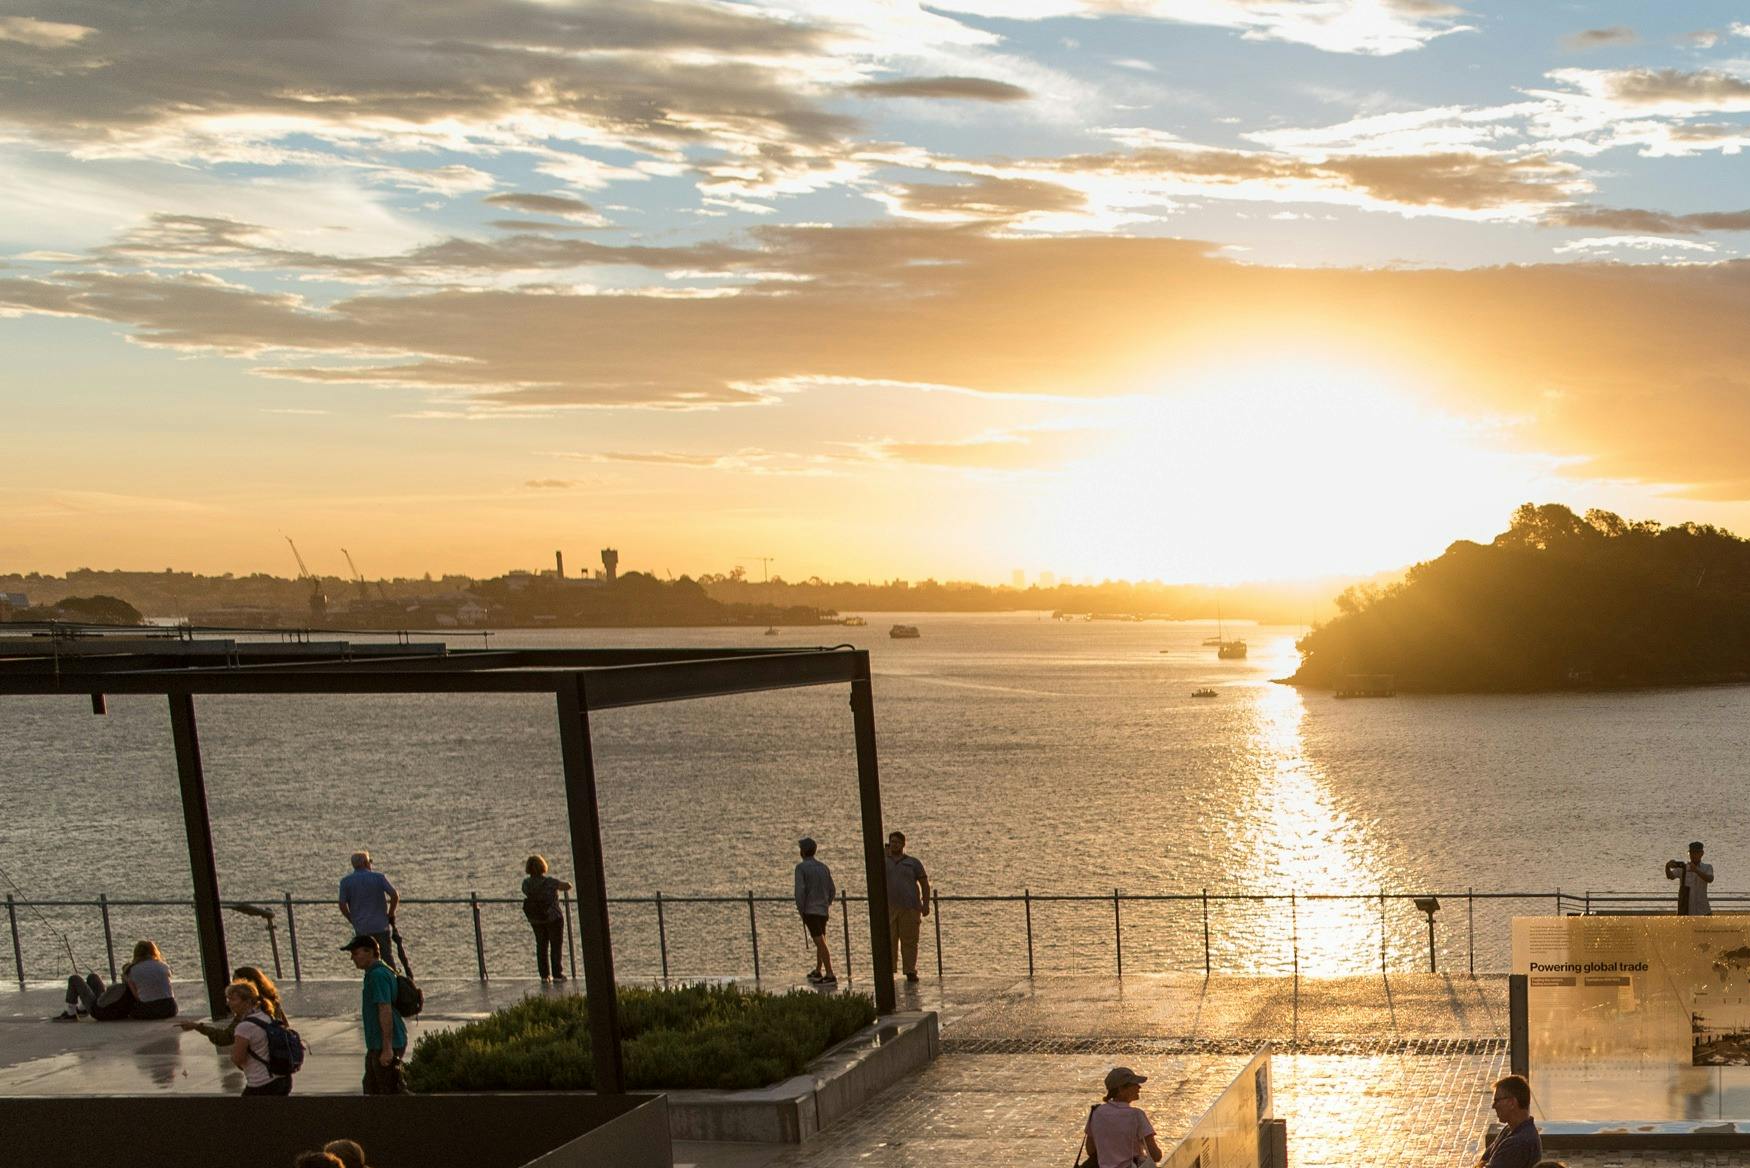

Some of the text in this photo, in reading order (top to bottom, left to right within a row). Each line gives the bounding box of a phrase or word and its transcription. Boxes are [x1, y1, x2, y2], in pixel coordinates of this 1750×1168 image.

[1530, 962, 1648, 973] Powering global trade
